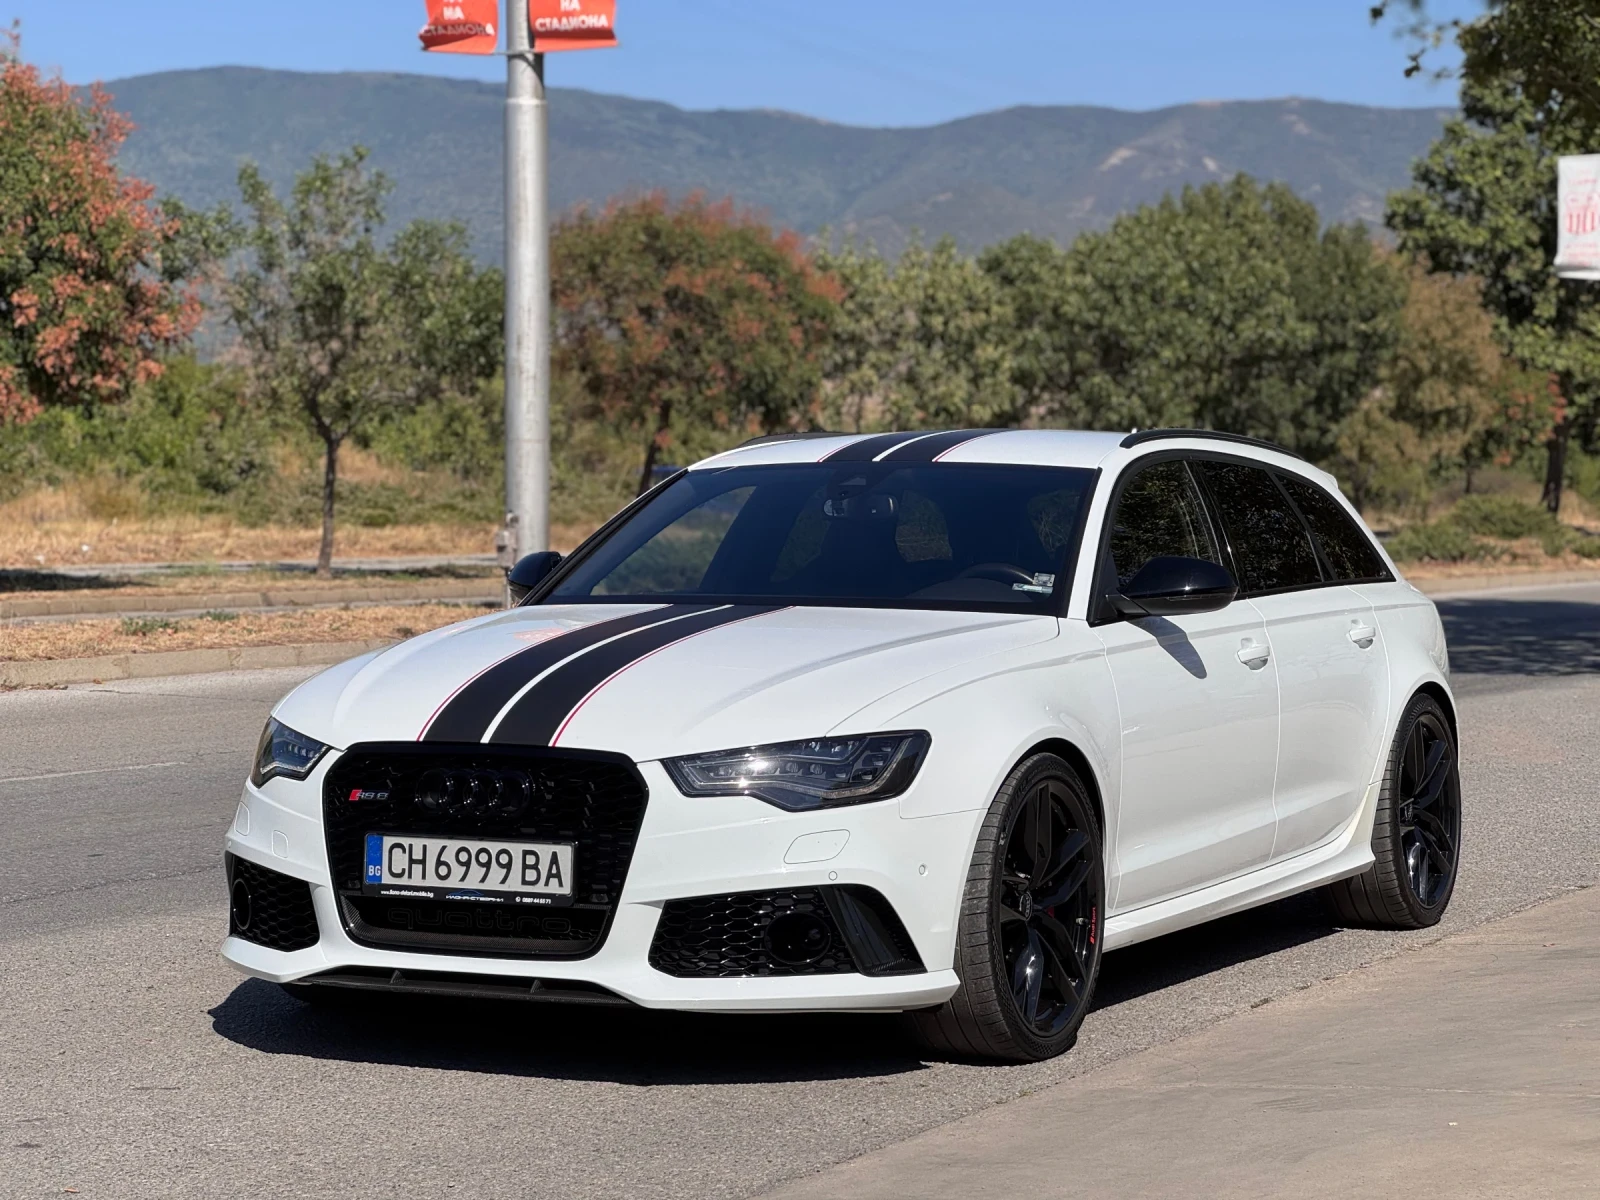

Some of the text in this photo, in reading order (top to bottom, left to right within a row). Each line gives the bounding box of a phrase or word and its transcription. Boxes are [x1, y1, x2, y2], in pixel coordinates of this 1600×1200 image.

[560, 0, 580, 11] НА
[443, 6, 464, 20] НА
[535, 14, 608, 31] СТАДИОНА
[368, 865, 381, 876] BG
[388, 907, 571, 934] quattro
